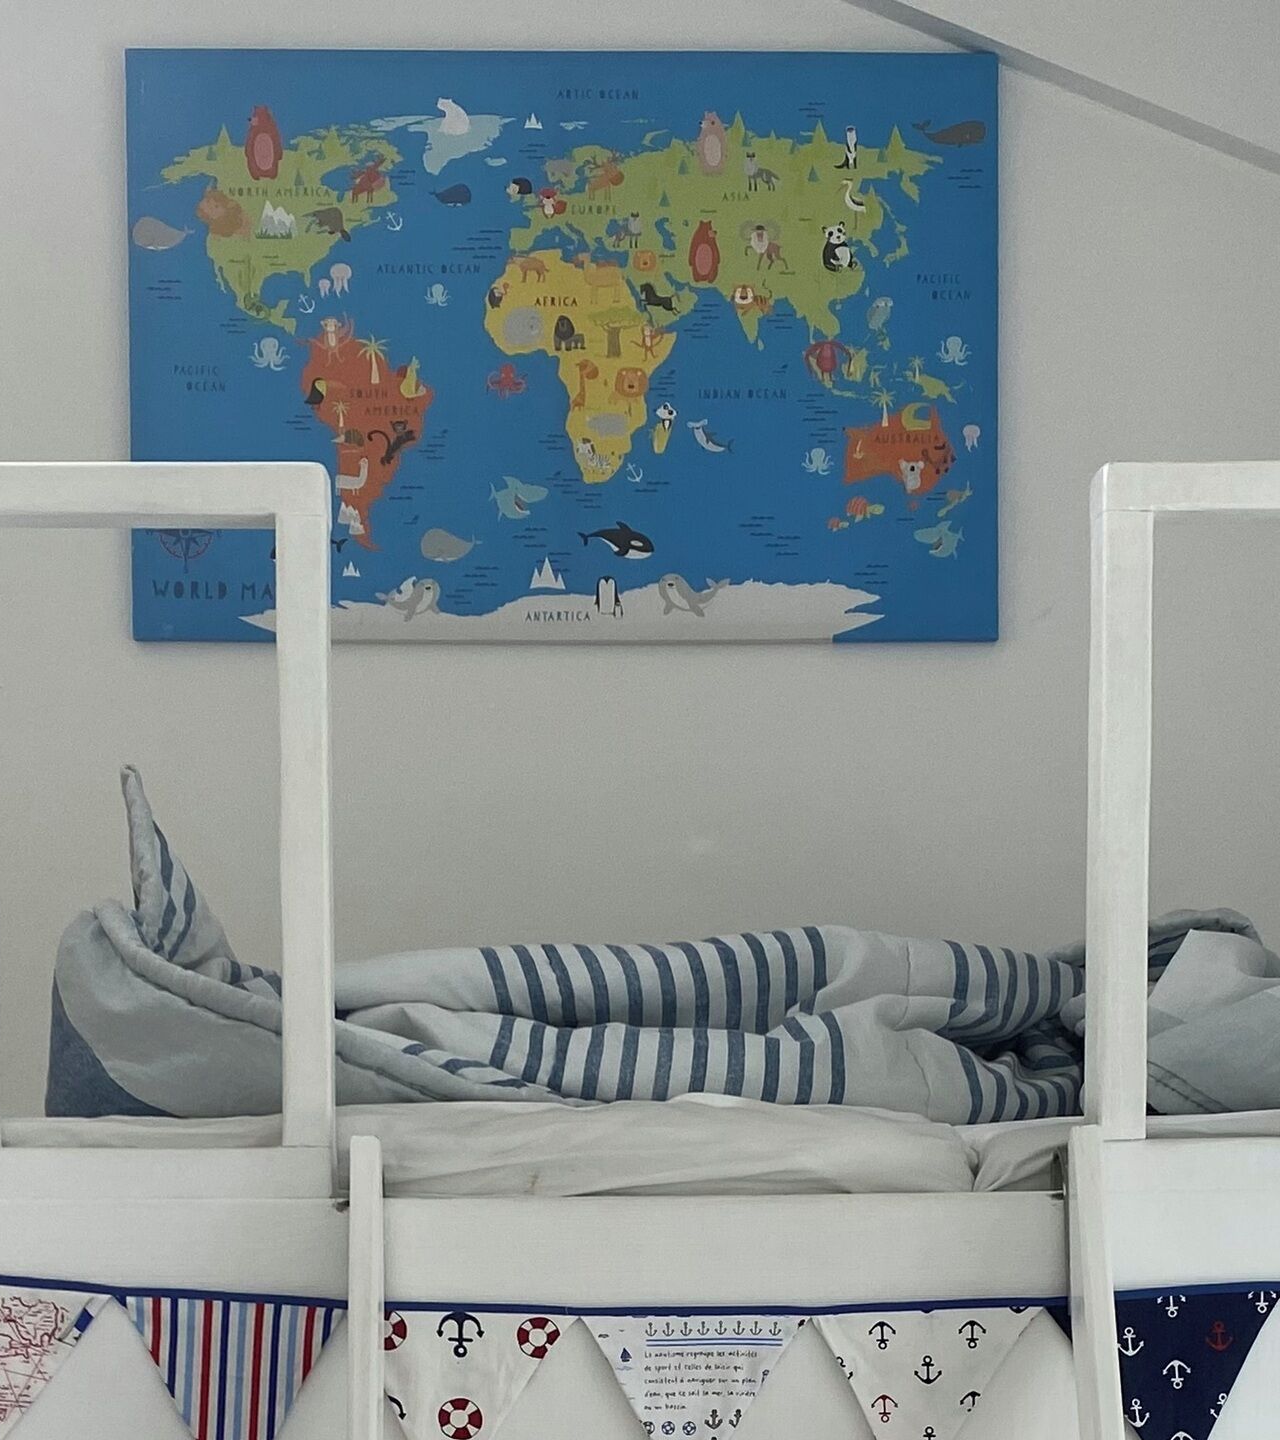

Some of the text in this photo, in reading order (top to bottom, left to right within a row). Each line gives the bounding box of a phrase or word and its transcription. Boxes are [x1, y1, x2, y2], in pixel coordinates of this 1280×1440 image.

[556, 88, 639, 100] ARTIC OCEAN
[228, 187, 331, 198] NORTH AMERICA
[722, 192, 750, 202] ASIA
[571, 205, 617, 215] EUROPE
[376, 263, 480, 274] ATLANTIC OCEAN
[917, 273, 961, 285] PACIFIC
[931, 290, 970, 300] OCEAN
[534, 296, 578, 307] AFRICA
[174, 365, 219, 376] PACIFIC
[186, 381, 225, 392] OCEAN
[350, 388, 388, 398] SOUTH
[698, 388, 787, 399] INDIAN OCEAN
[364, 405, 418, 416] AMERICA
[875, 433, 938, 444] AUSTRALIA
[152, 580, 228, 600] WORLD
[525, 610, 591, 622] ANTARTICA
